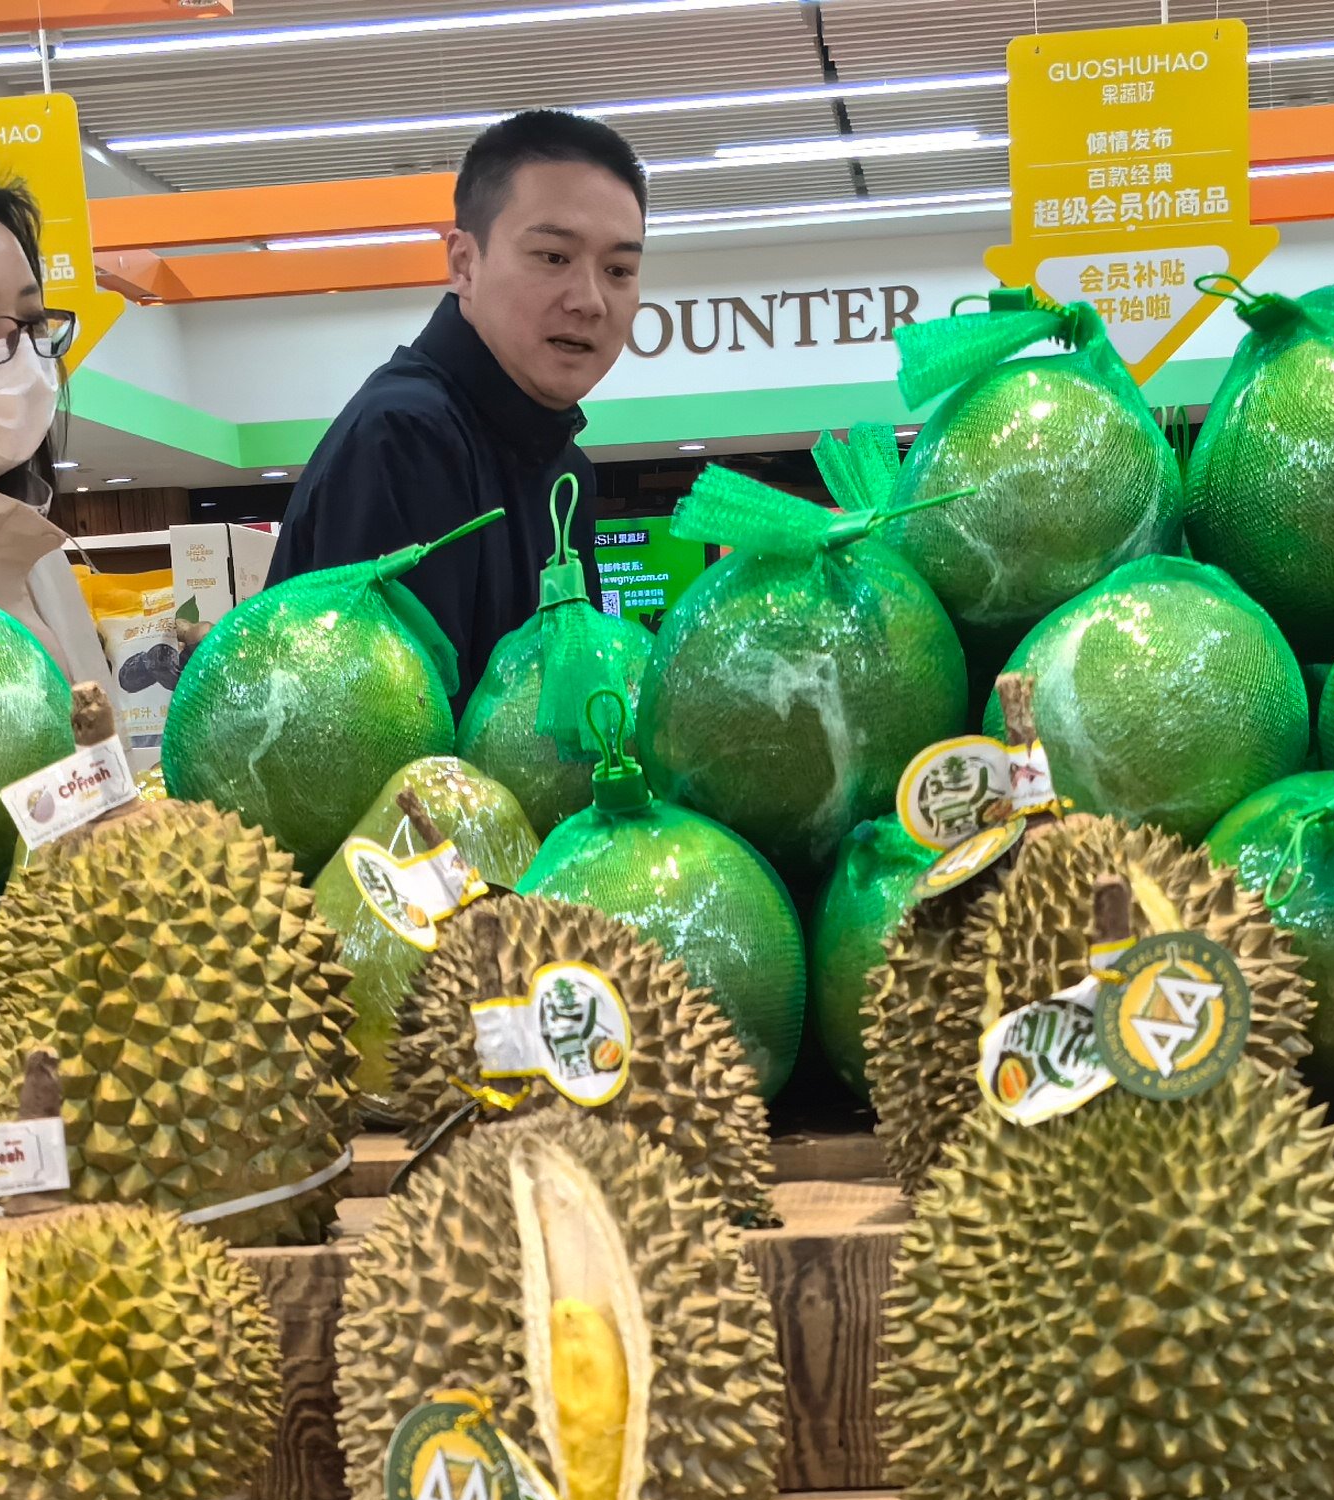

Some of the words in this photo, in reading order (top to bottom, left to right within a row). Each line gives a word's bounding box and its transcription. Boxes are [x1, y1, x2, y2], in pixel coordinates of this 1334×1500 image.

[1048, 51, 1208, 83] GUOSHUHAO
[1101, 81, 1155, 105] 果蔬好
[1086, 127, 1173, 155] 倾情发布
[1087, 162, 1173, 190] 百款经典
[1033, 186, 1230, 229] 超级会员价商品
[1078, 258, 1186, 294] 会员补贴
[1093, 295, 1172, 324] 开始啦
[595, 533, 617, 545] SH
[1130, 975, 1224, 1080] AA
